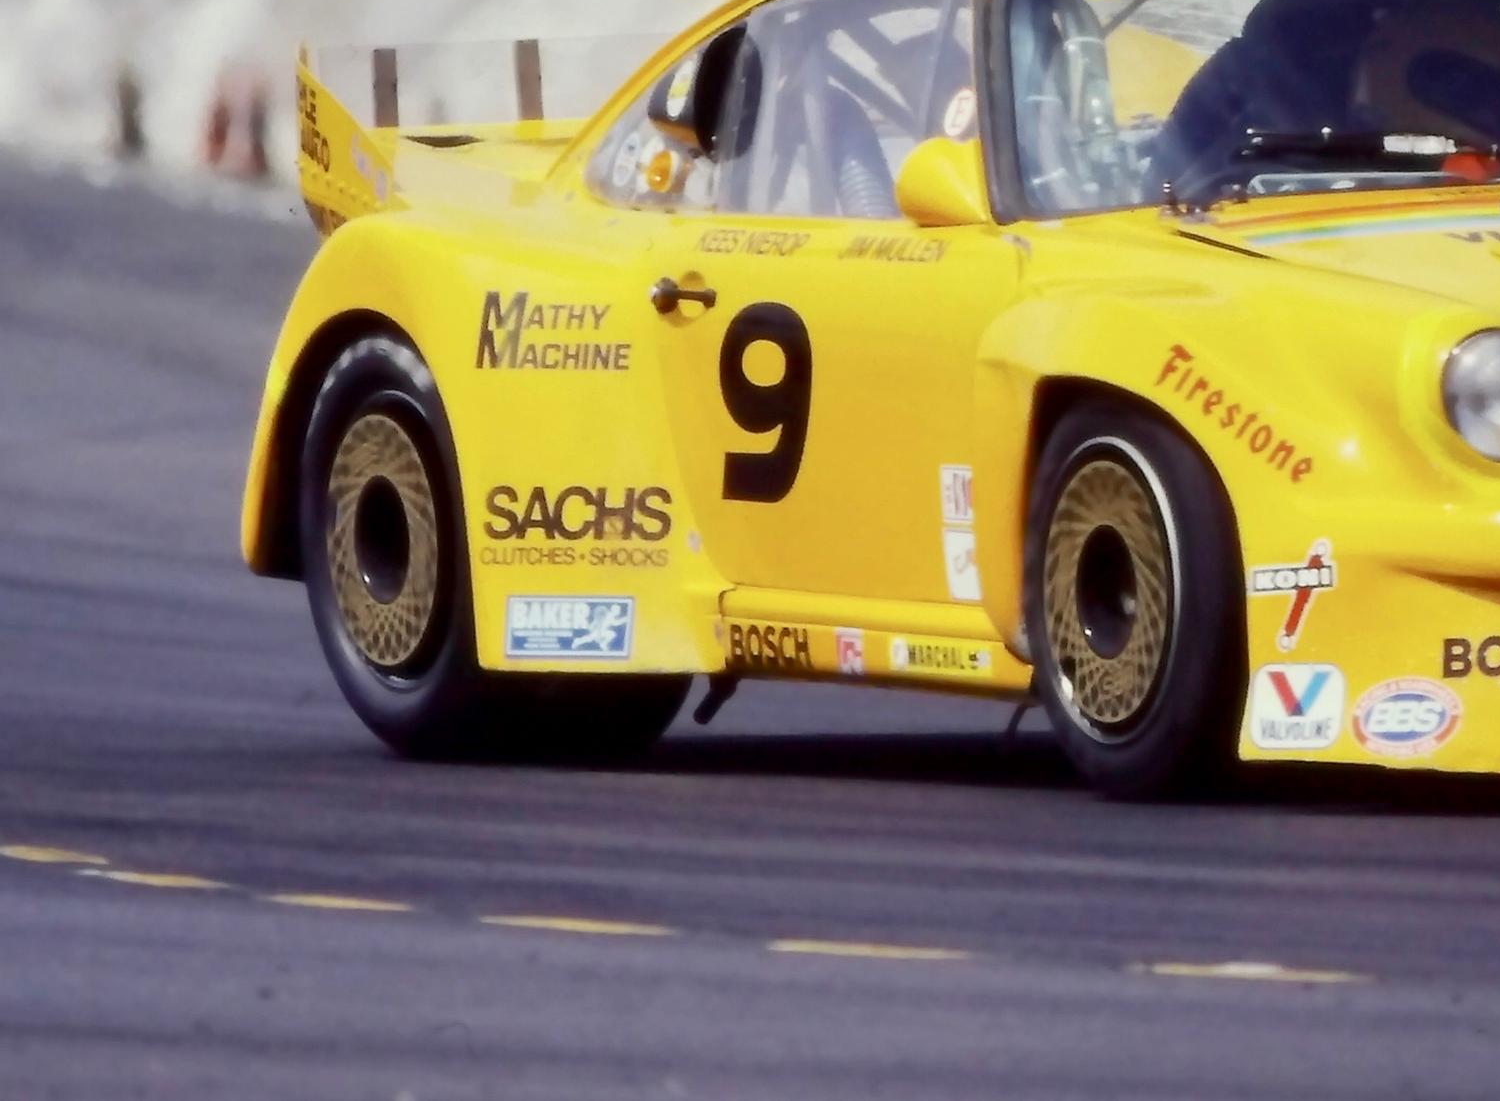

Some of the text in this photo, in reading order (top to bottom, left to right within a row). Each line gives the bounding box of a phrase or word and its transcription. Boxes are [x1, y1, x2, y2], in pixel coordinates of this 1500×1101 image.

[719, 302, 812, 503] 9
[1154, 344, 1313, 483] Firestone
[484, 486, 672, 541] SACHS
[480, 547, 669, 567] CLUTCHES SHOCKS
[1255, 568, 1331, 590] KONI
[512, 602, 590, 628] BAKER
[730, 624, 813, 668] BOSCH
[1260, 717, 1333, 742] VALVOLINE
[1367, 702, 1442, 732] BBS
